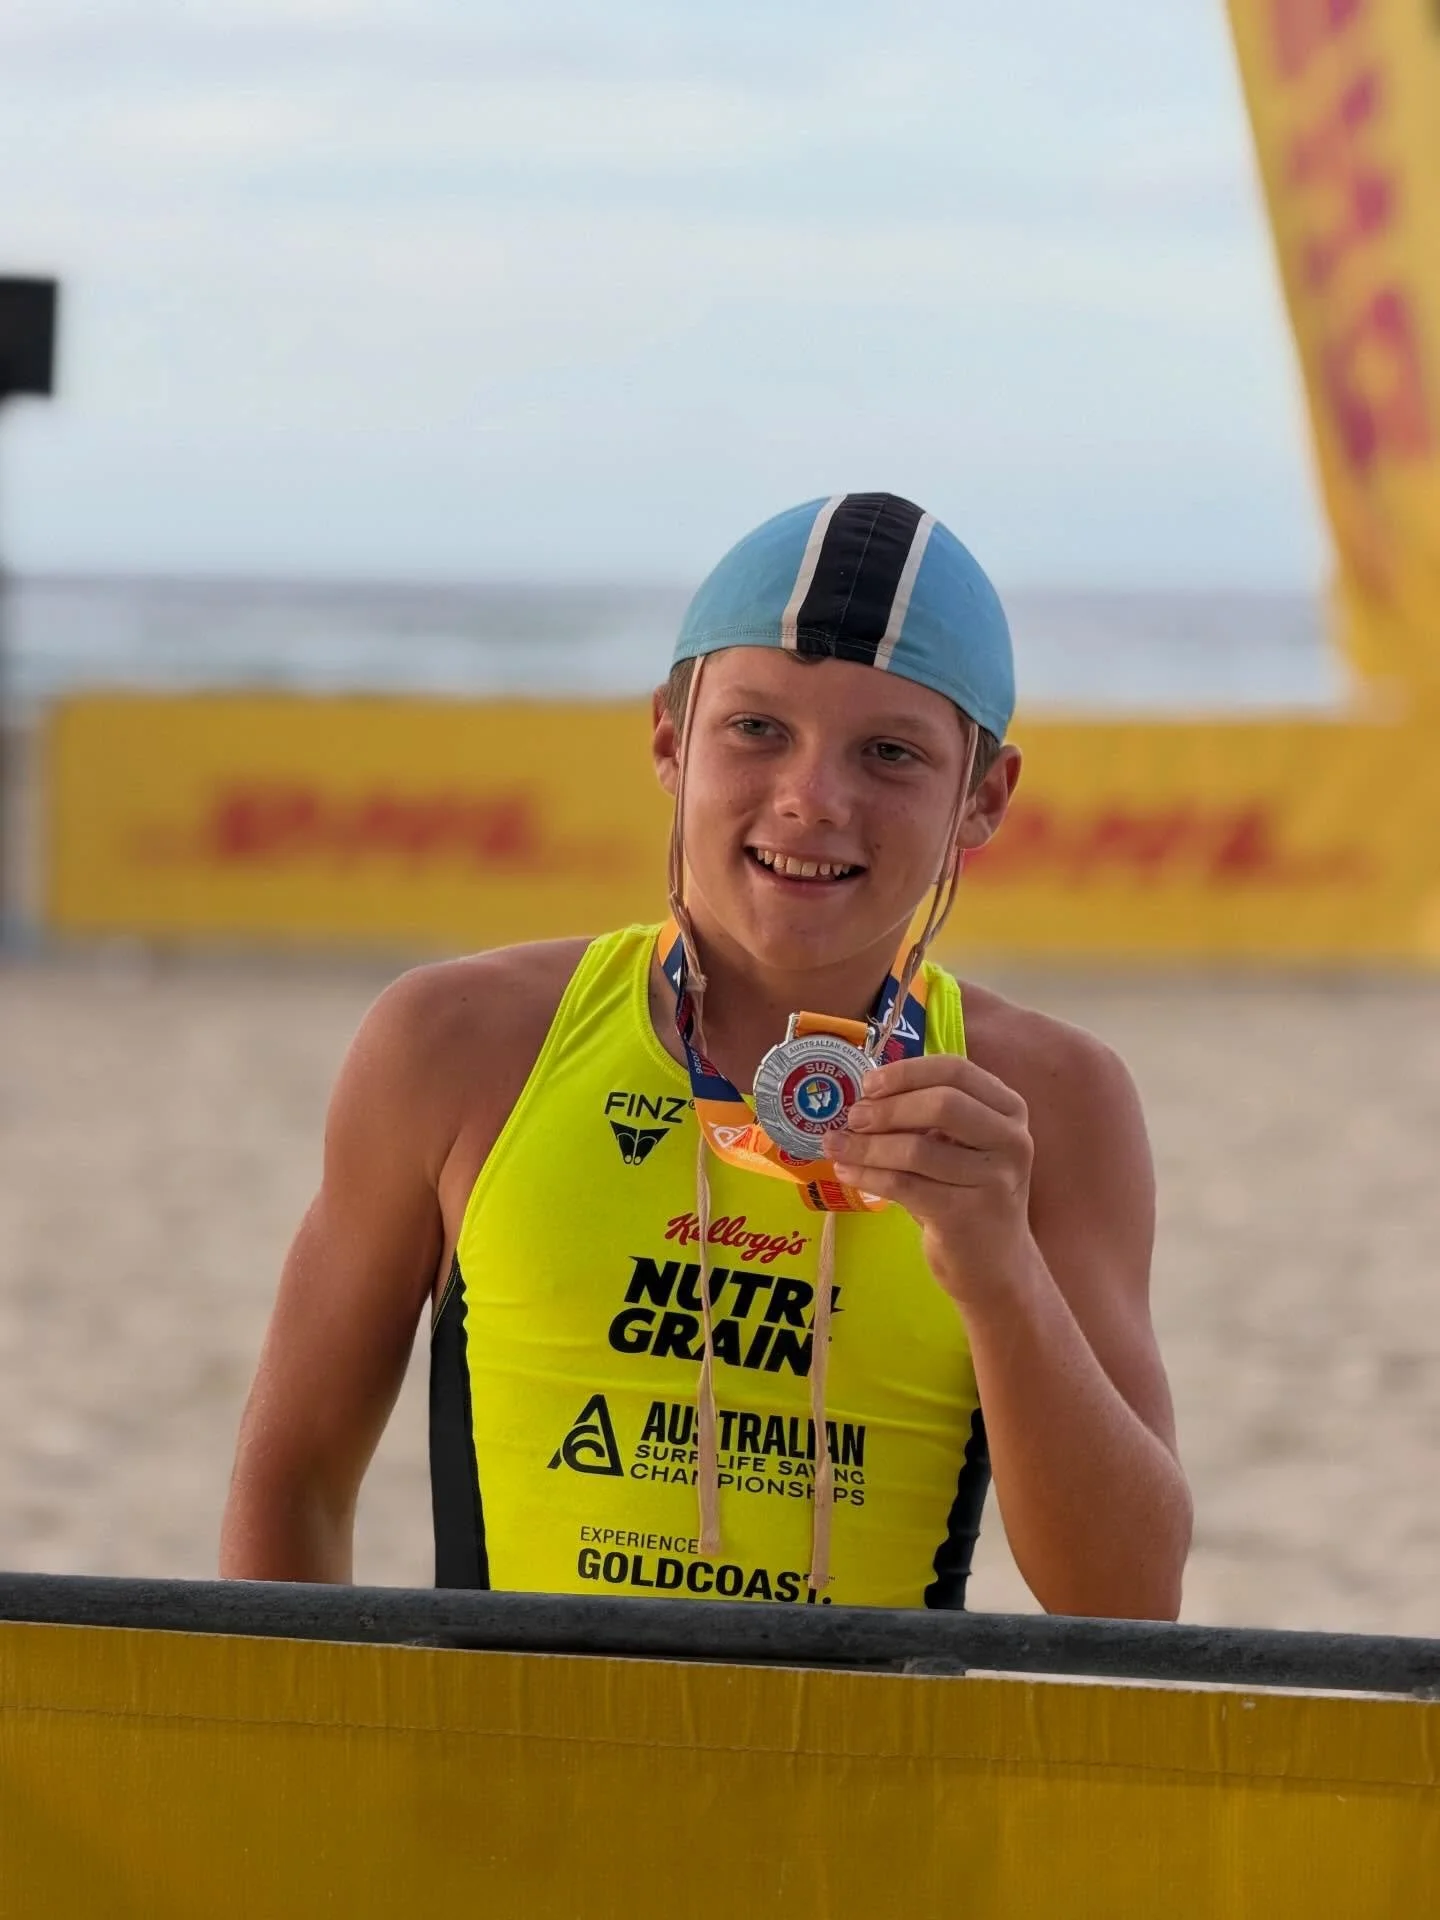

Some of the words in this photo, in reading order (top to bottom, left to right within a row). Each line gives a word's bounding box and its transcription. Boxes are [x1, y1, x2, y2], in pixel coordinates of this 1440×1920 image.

[789, 1039, 841, 1054] AUSTRALIAN
[806, 1062, 846, 1079] SURF
[604, 1091, 688, 1124] FINZ
[783, 1095, 803, 1126] LIFE
[640, 1401, 866, 1468] AUTRALIAN
[634, 1444, 699, 1465] SURF
[715, 1453, 766, 1474] LIFE
[778, 1460, 866, 1485] SANG
[630, 1462, 865, 1507] CHAPIONSHPS
[580, 1525, 699, 1554] EXPERIENCE
